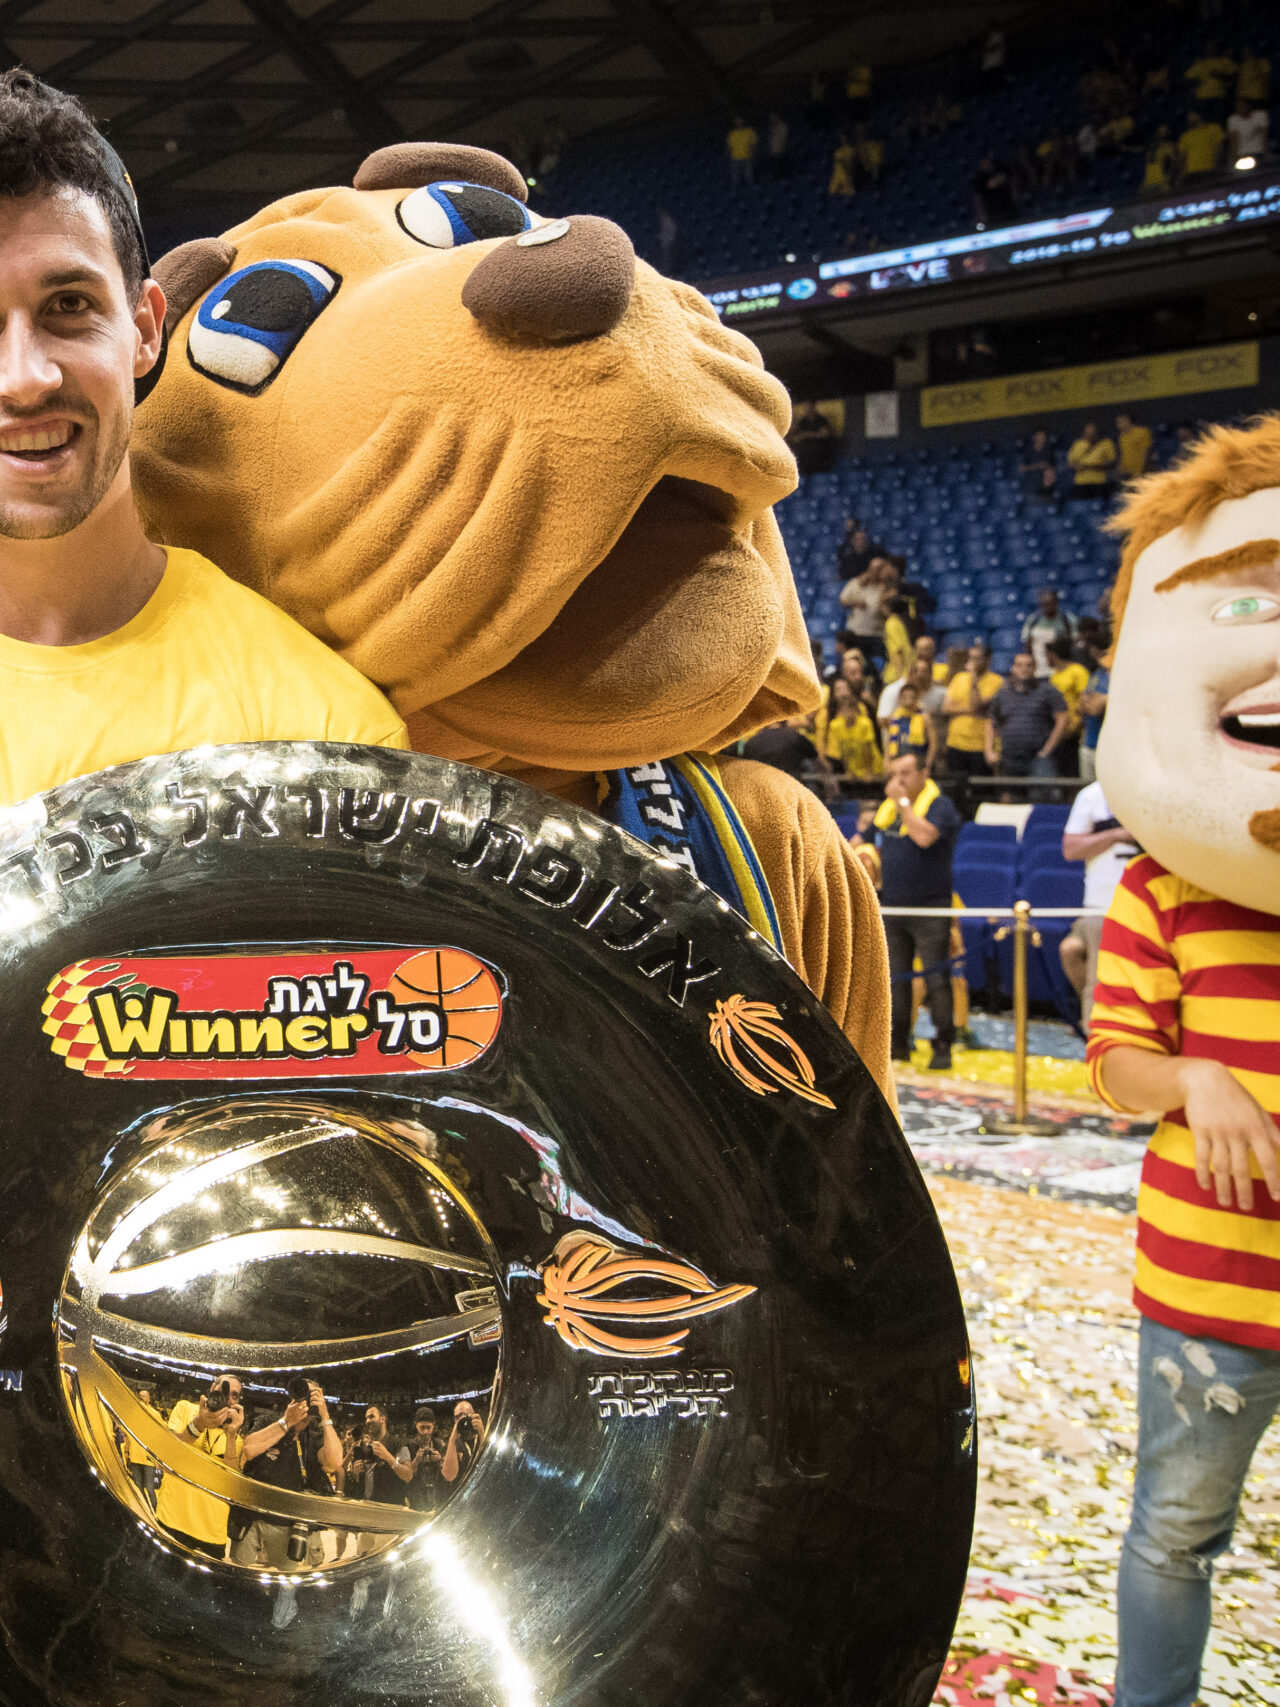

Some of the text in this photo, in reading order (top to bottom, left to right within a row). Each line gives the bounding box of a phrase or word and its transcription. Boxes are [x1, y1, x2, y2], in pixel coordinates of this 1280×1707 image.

[164, 783, 441, 848] ישראל
[453, 818, 721, 1007] אלופת
[268, 965, 366, 1014] ליגת
[93, 990, 369, 1053] Winner
[375, 998, 442, 1048] סל
